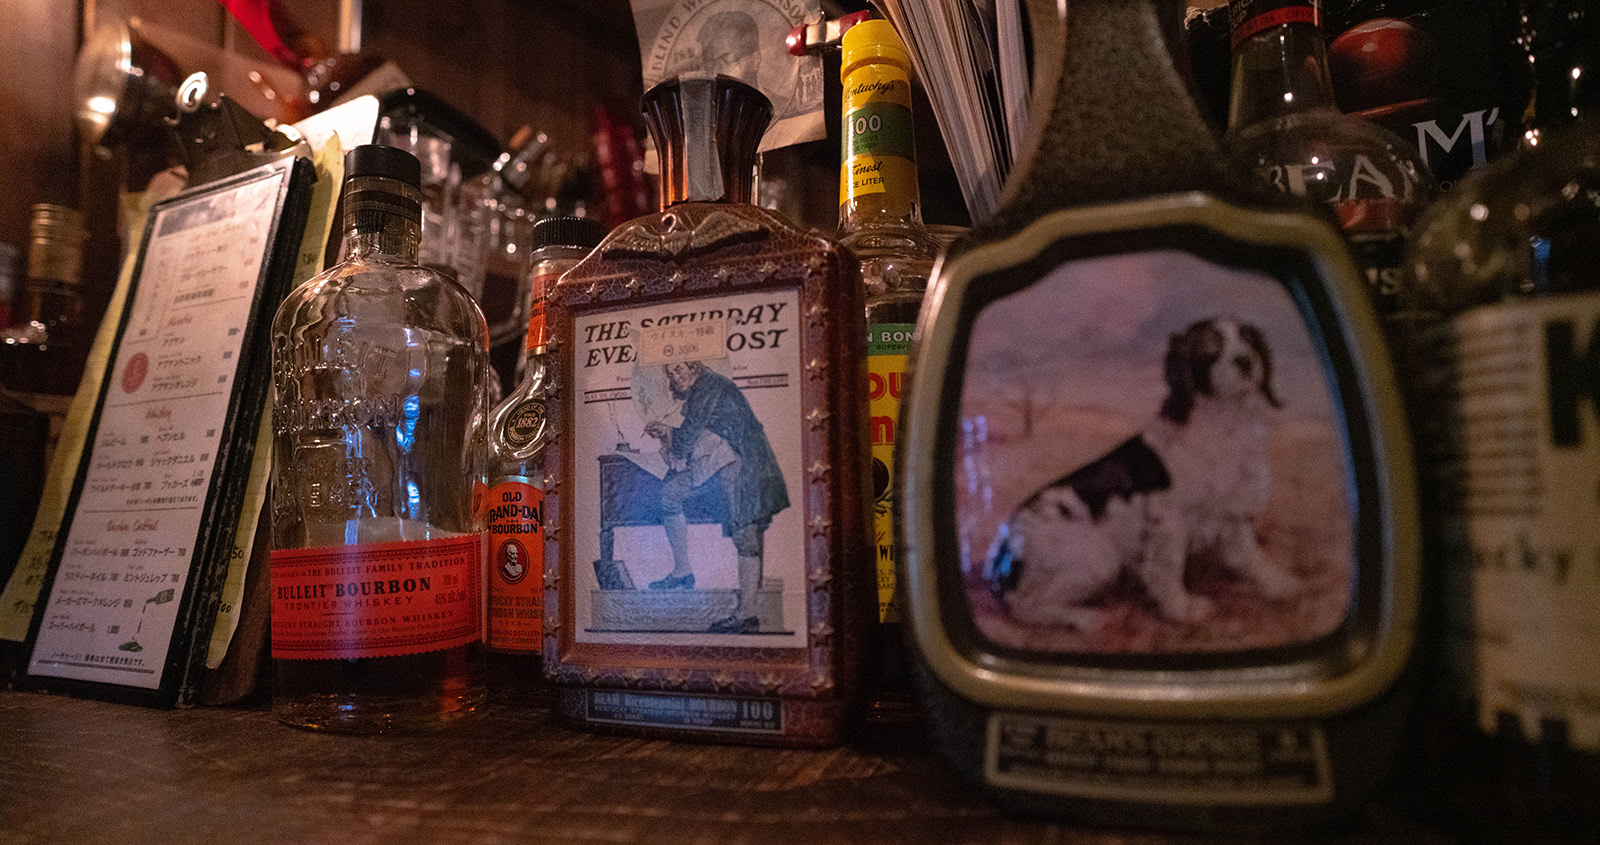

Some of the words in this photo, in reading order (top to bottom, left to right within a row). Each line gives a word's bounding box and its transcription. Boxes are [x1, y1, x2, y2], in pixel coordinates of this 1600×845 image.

[652, 16, 682, 70] BLIND
[861, 177, 885, 186] LITER
[584, 321, 631, 344] THE
[726, 329, 788, 351] OST
[516, 417, 538, 429] 1882
[502, 492, 522, 503] OLD
[492, 524, 538, 535] BOURBON
[308, 569, 322, 577] THE
[325, 565, 361, 576] BULLEIT
[366, 562, 403, 574] FAMILY
[409, 557, 466, 571] TRADITION
[277, 583, 328, 600] BULLEIT
[335, 577, 431, 598] BOURBON
[285, 600, 338, 611] FRONTIER
[344, 596, 414, 608] WHISKEY
[299, 619, 342, 629] STRAIGHT
[345, 616, 397, 627] BOURBON
[402, 609, 455, 624] WHISKEY
[594, 692, 620, 705] BEAM
[741, 701, 774, 720] 100
